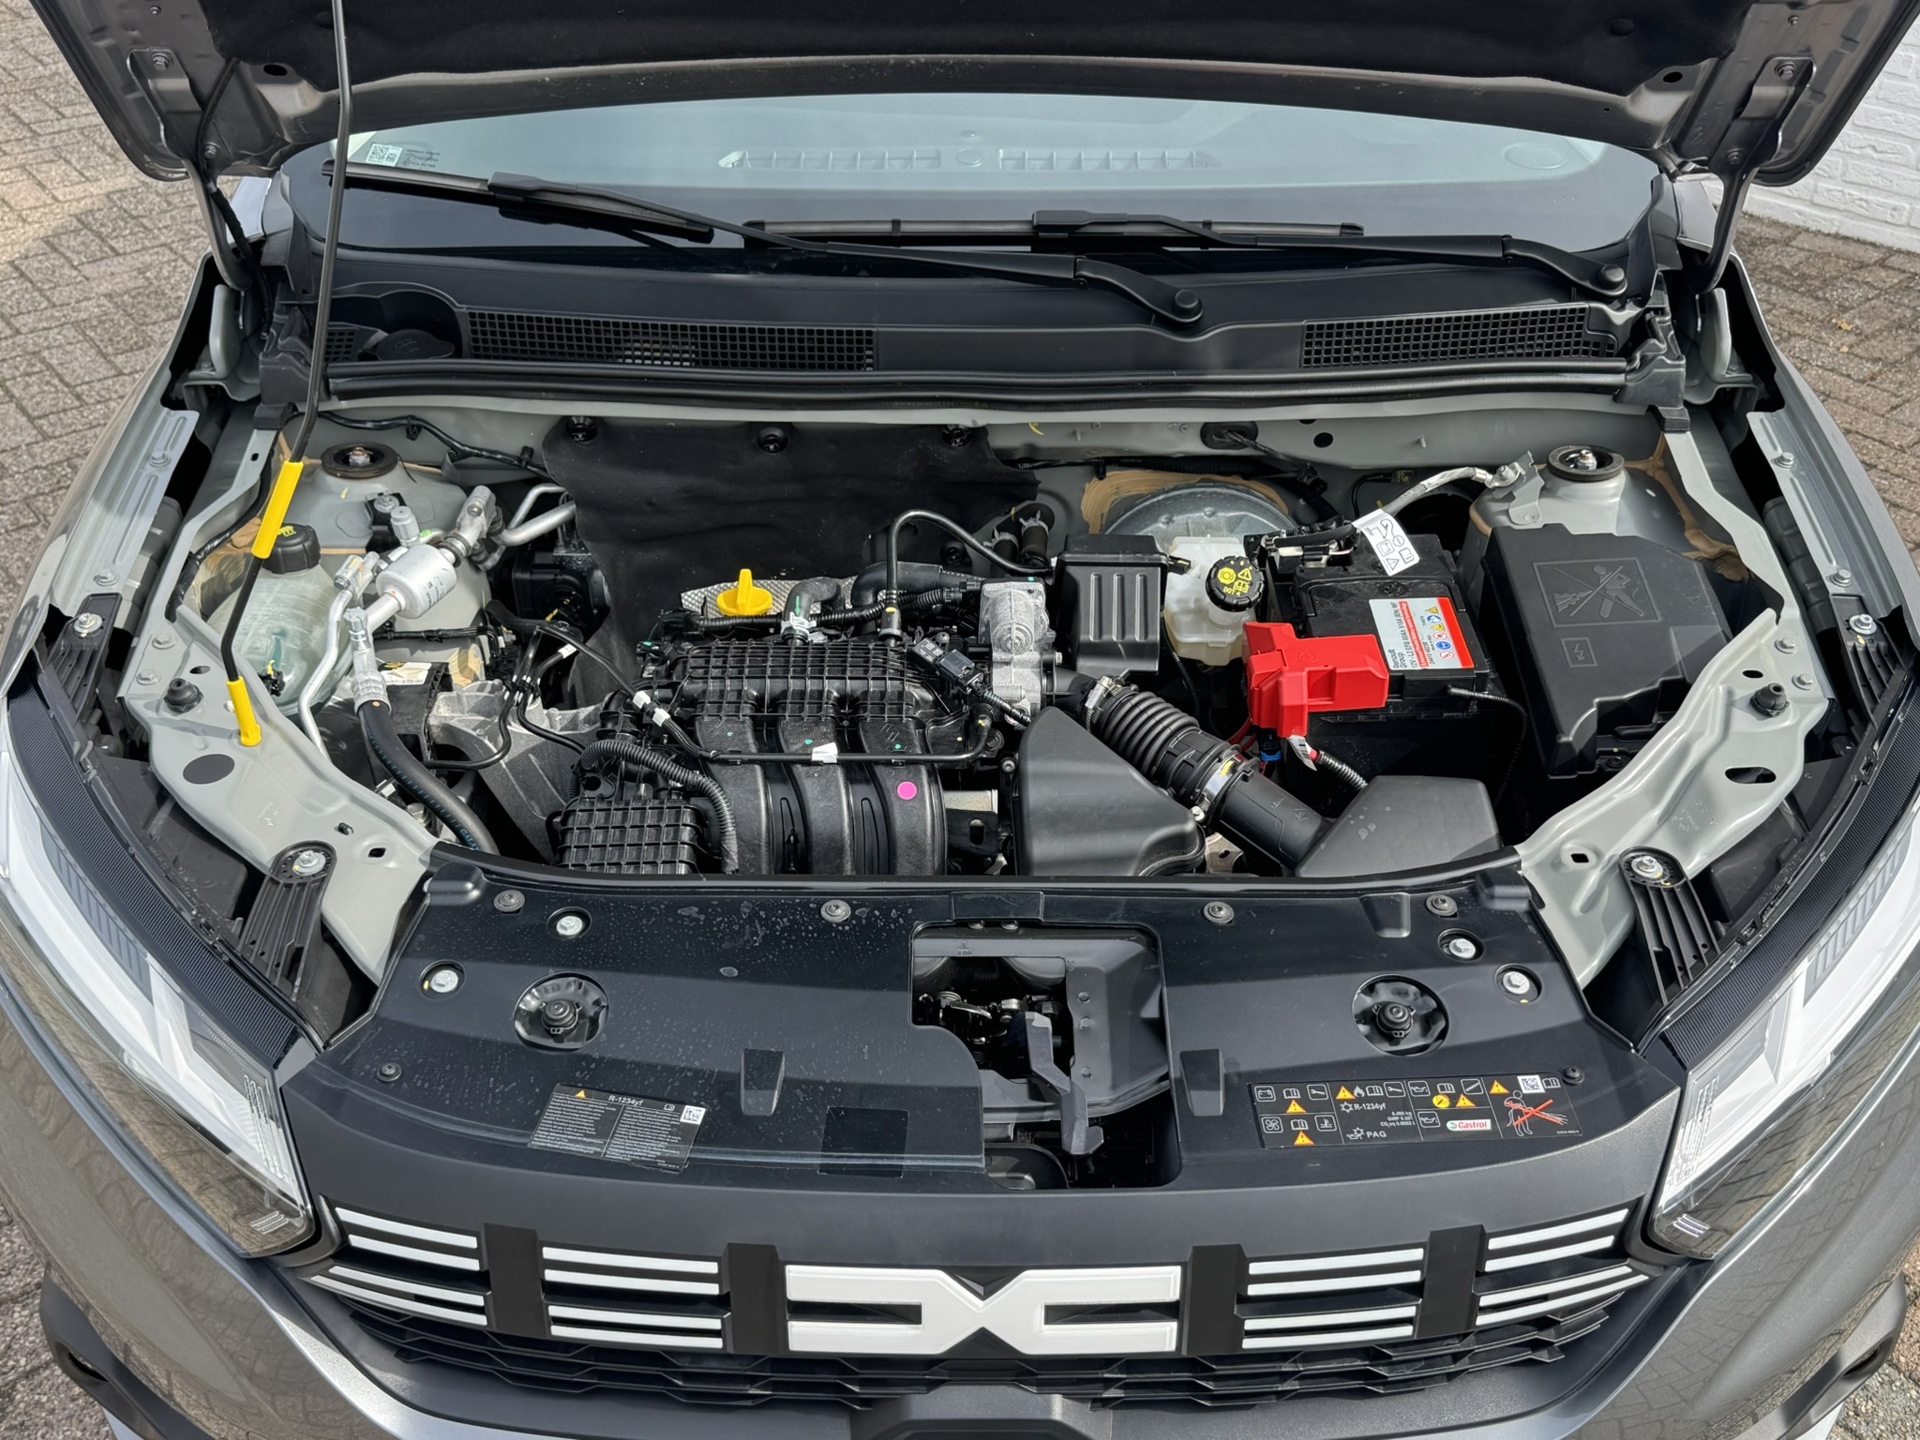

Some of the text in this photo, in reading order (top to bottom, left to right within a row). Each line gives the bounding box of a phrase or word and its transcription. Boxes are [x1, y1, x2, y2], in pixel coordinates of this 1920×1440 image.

[1388, 648, 1399, 668] Renault
[1398, 652, 1407, 668] Group
[609, 1094, 644, 1107] R-1234yf
[1353, 1102, 1386, 1111] R-1234yf
[1458, 1120, 1487, 1129] Castrol
[1366, 1130, 1387, 1138] PAG
